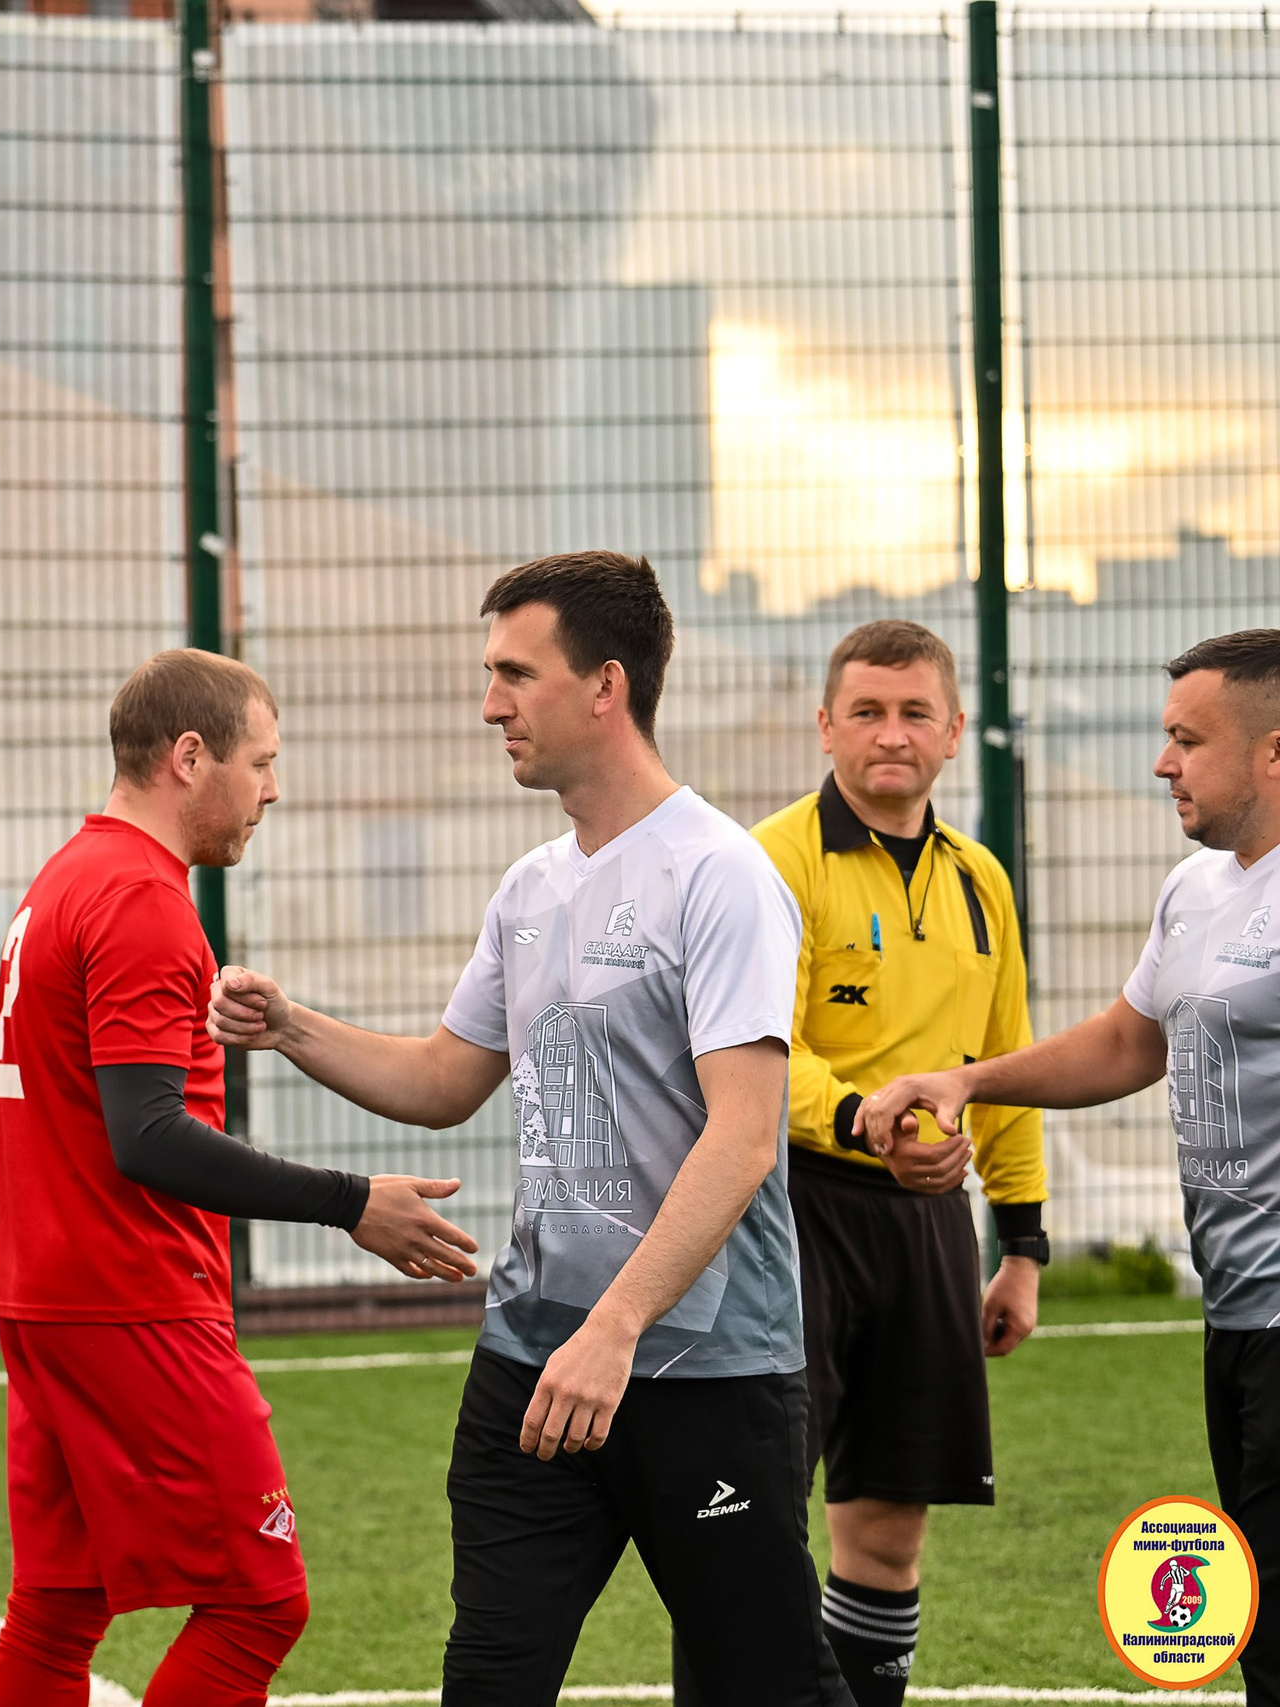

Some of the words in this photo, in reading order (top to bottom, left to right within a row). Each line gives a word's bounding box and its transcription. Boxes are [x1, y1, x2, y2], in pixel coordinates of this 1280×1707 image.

[584, 941, 649, 959] СТАНДАРТ
[827, 984, 870, 1006] 2K
[696, 1499, 751, 1519] DEMIX
